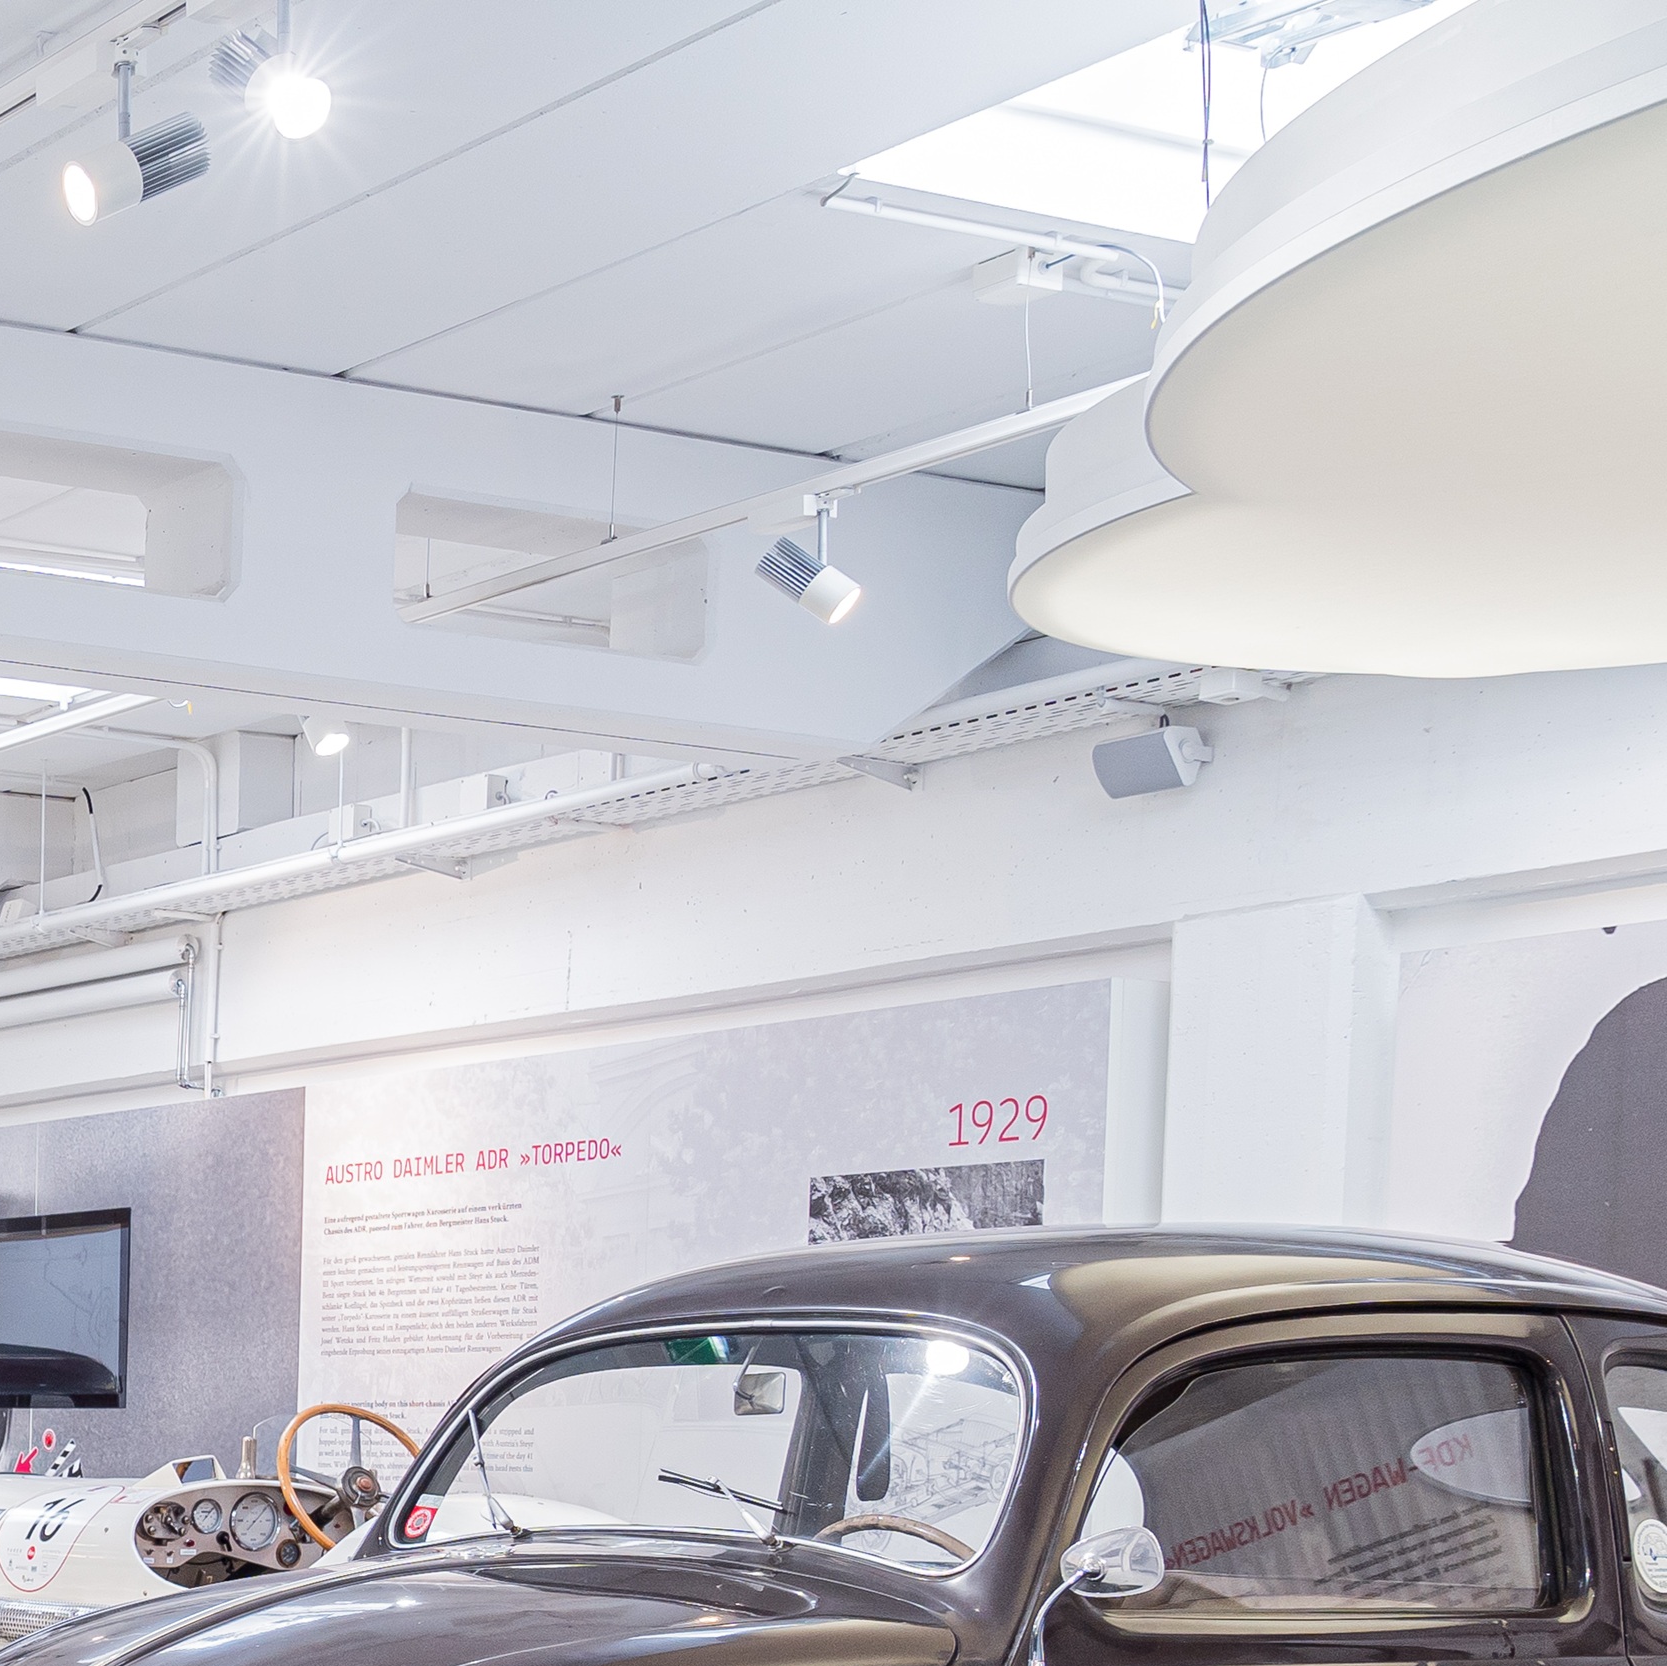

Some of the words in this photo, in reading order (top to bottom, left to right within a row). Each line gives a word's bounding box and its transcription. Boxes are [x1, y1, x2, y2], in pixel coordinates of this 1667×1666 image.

[949, 1095, 1047, 1146] 1929
[325, 1160, 382, 1185] AUSTRO
[393, 1153, 464, 1178] DAIMLER
[476, 1148, 508, 1171] ADR
[520, 1138, 622, 1166] »TORPEDO«
[26, 1498, 86, 1541] 16
